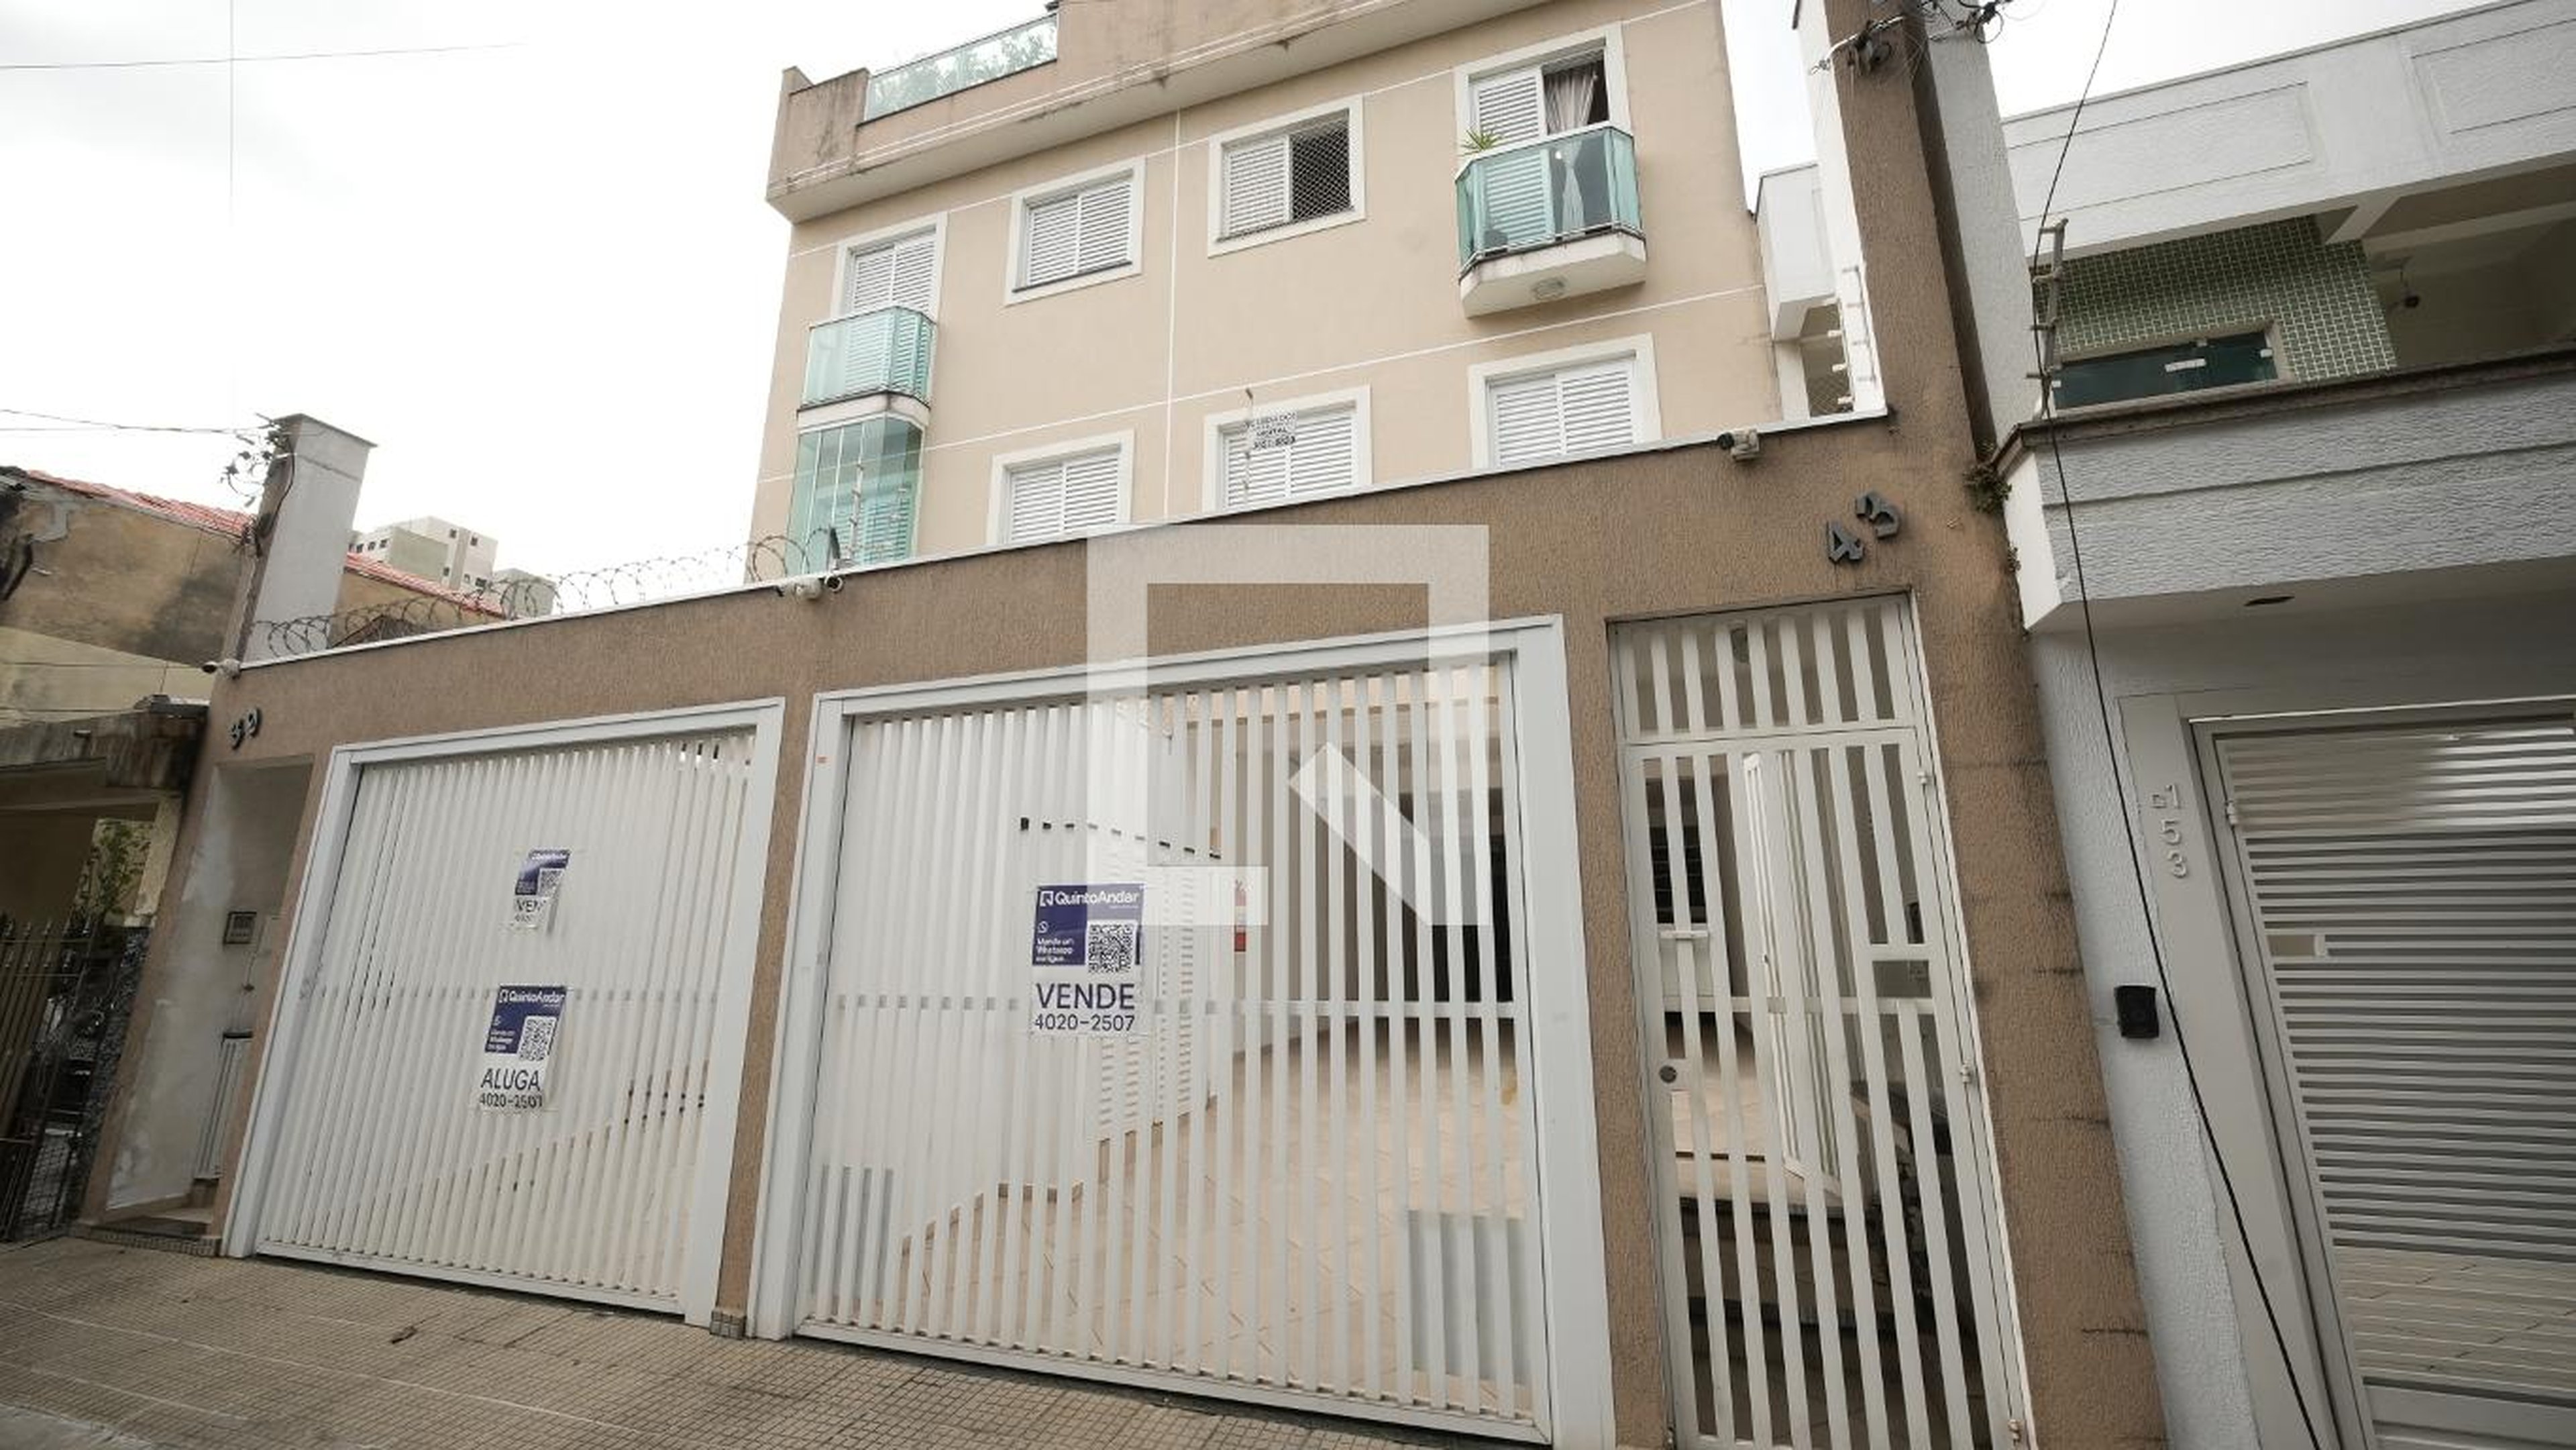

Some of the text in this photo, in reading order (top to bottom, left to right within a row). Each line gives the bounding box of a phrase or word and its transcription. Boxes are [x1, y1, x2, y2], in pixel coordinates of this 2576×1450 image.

[1825, 490, 1900, 562] 43
[1055, 890, 1138, 905] QuintoAndar
[1036, 984, 1135, 1009] VENDE
[1034, 1013, 1135, 1031] 4020-2507
[480, 1068, 541, 1091] ALUGA
